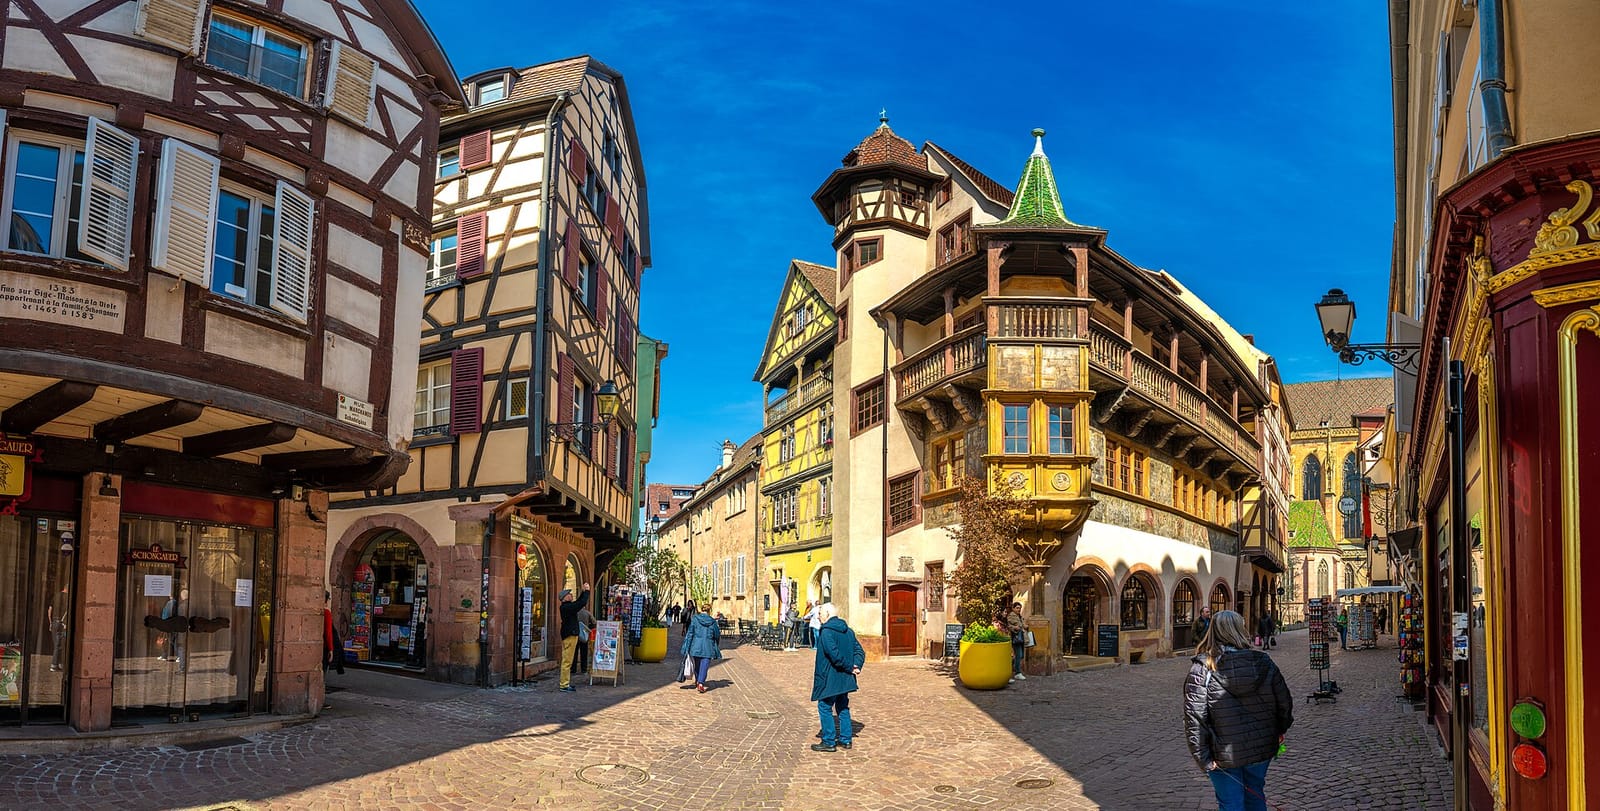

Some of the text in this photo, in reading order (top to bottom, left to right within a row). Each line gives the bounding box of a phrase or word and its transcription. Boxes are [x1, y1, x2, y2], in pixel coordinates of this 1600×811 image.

[61, 301, 84, 311] famille
[90, 298, 97, 306] la
[35, 305, 57, 314] 1465
[353, 401, 365, 409] RUE
[152, 545, 160, 553] LE
[131, 550, 178, 562] SCHONGAUER
